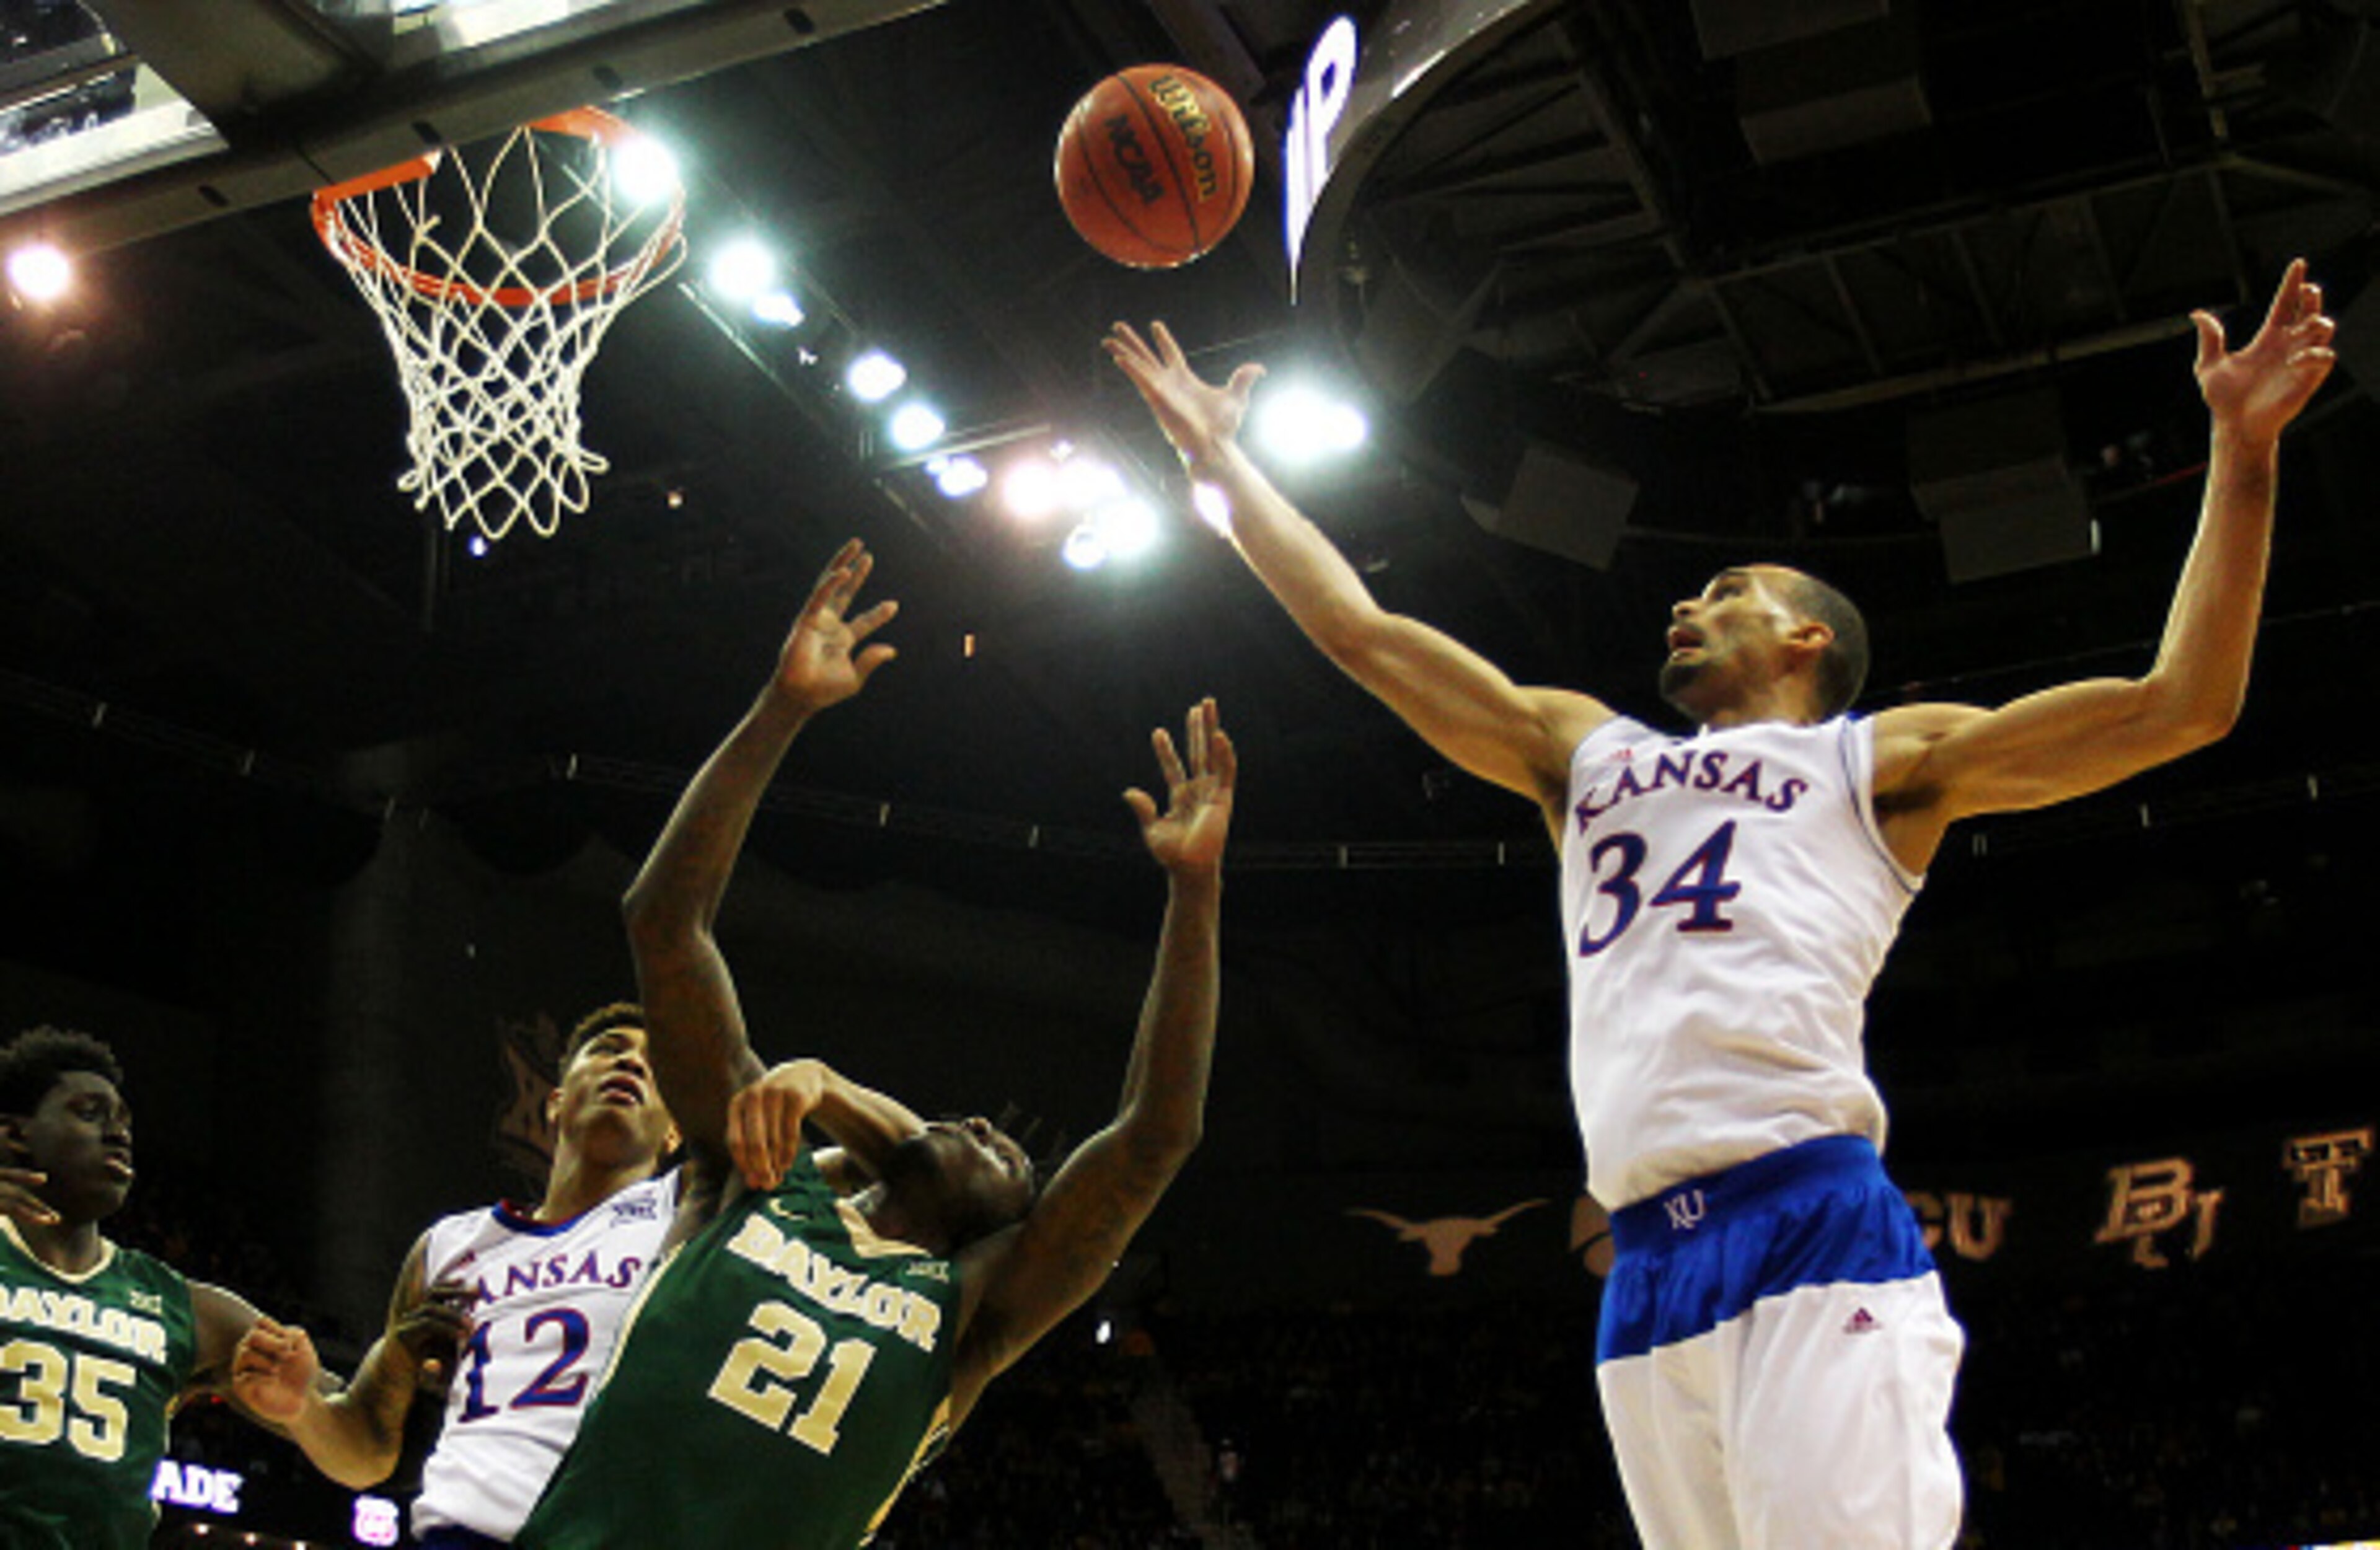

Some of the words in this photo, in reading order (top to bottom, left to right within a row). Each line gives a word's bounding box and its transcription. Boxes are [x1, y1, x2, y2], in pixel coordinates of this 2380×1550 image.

[1576, 749, 1808, 835] KANSAS
[1579, 819, 1741, 958] 34
[470, 1250, 641, 1308] ANSAS
[725, 1211, 943, 1354] BAYLOR
[0, 1339, 136, 1461] 35
[457, 1308, 589, 1424] 12
[706, 1299, 878, 1457] 21
